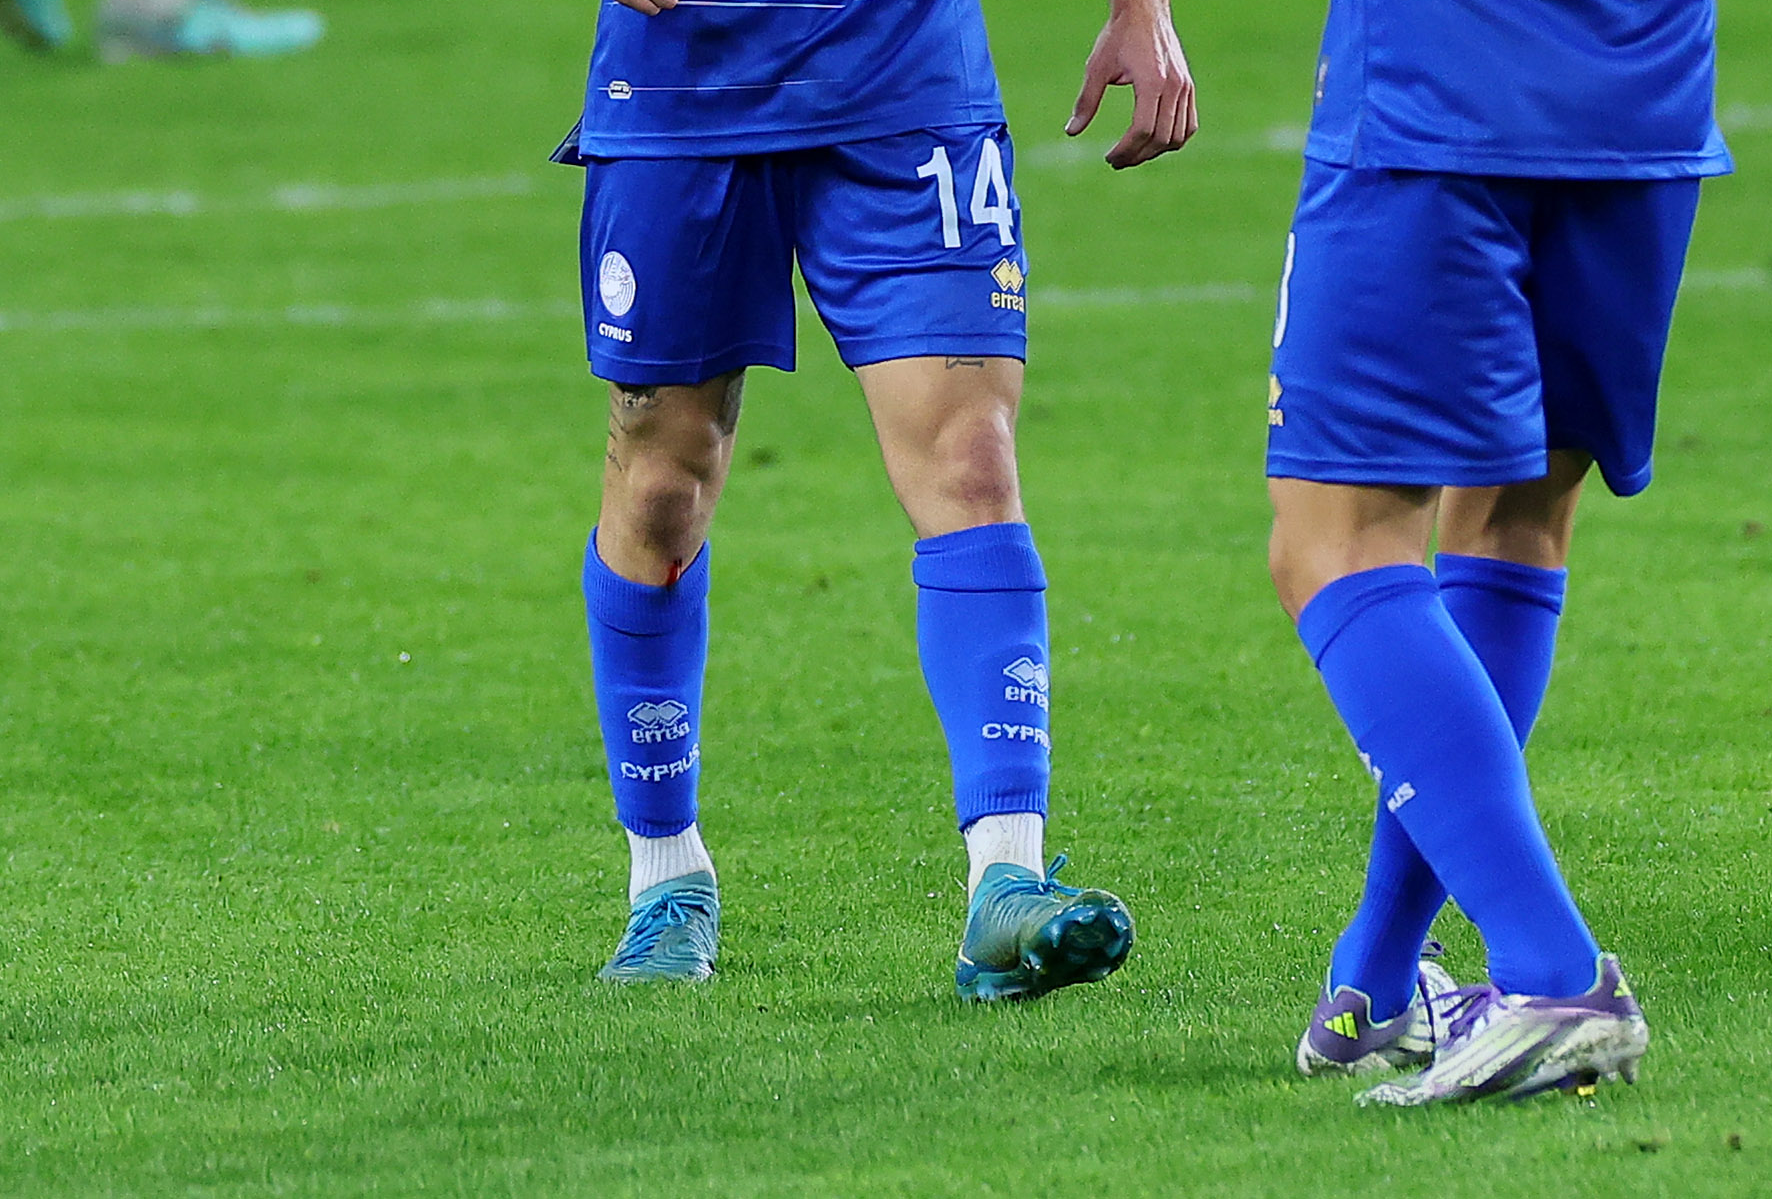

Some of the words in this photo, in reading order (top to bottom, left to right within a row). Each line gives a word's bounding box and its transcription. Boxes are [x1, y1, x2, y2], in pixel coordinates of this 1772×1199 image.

[915, 136, 1017, 249] 14
[598, 321, 633, 343] CYPRUS
[1004, 685, 1049, 713] erre
[981, 722, 1053, 756] CYPR
[620, 742, 701, 783] CYPRUS
